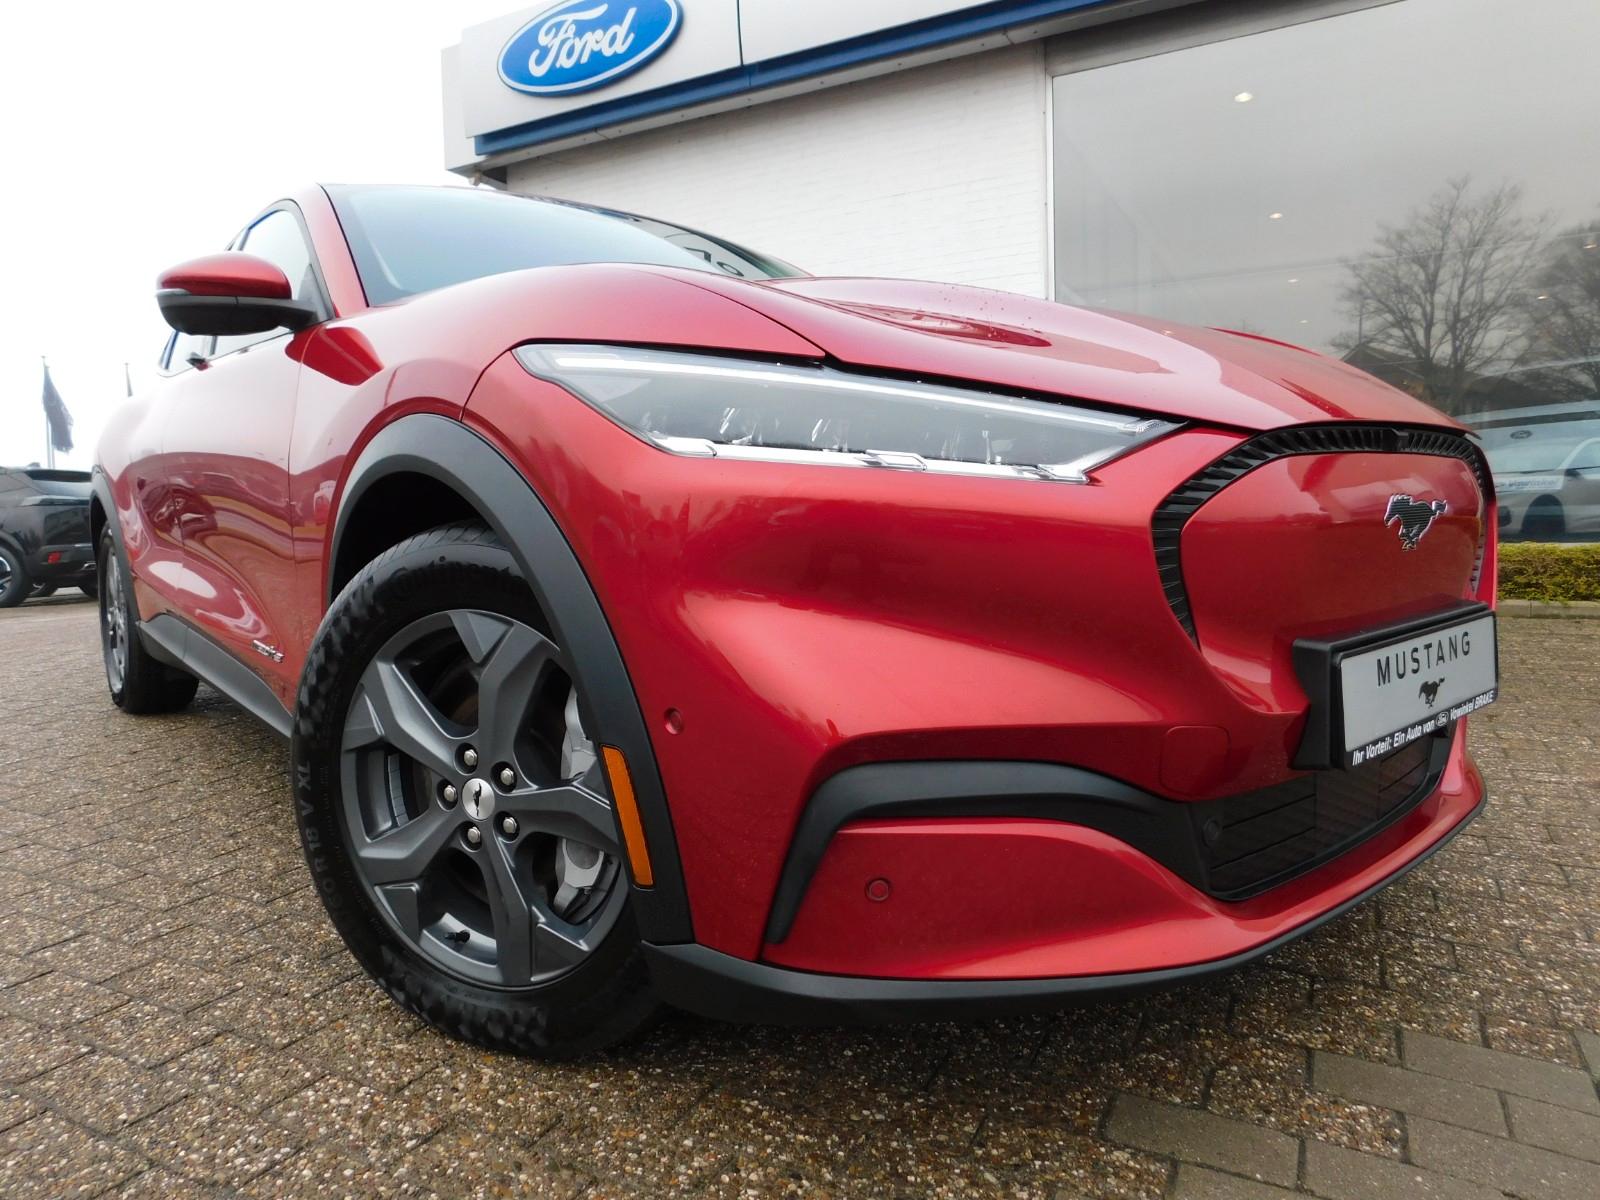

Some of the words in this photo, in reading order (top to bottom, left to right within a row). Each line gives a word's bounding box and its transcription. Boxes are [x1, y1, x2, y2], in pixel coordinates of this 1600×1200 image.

[528, 3, 637, 77] Ford
[1377, 632, 1470, 686] MUSTANG
[1352, 749, 1364, 766] Ihr
[1366, 736, 1392, 760] Vorteil:
[1393, 731, 1405, 748] Ein
[1406, 724, 1422, 742] Auto
[1423, 720, 1435, 734] von
[297, 761, 312, 791] XL
